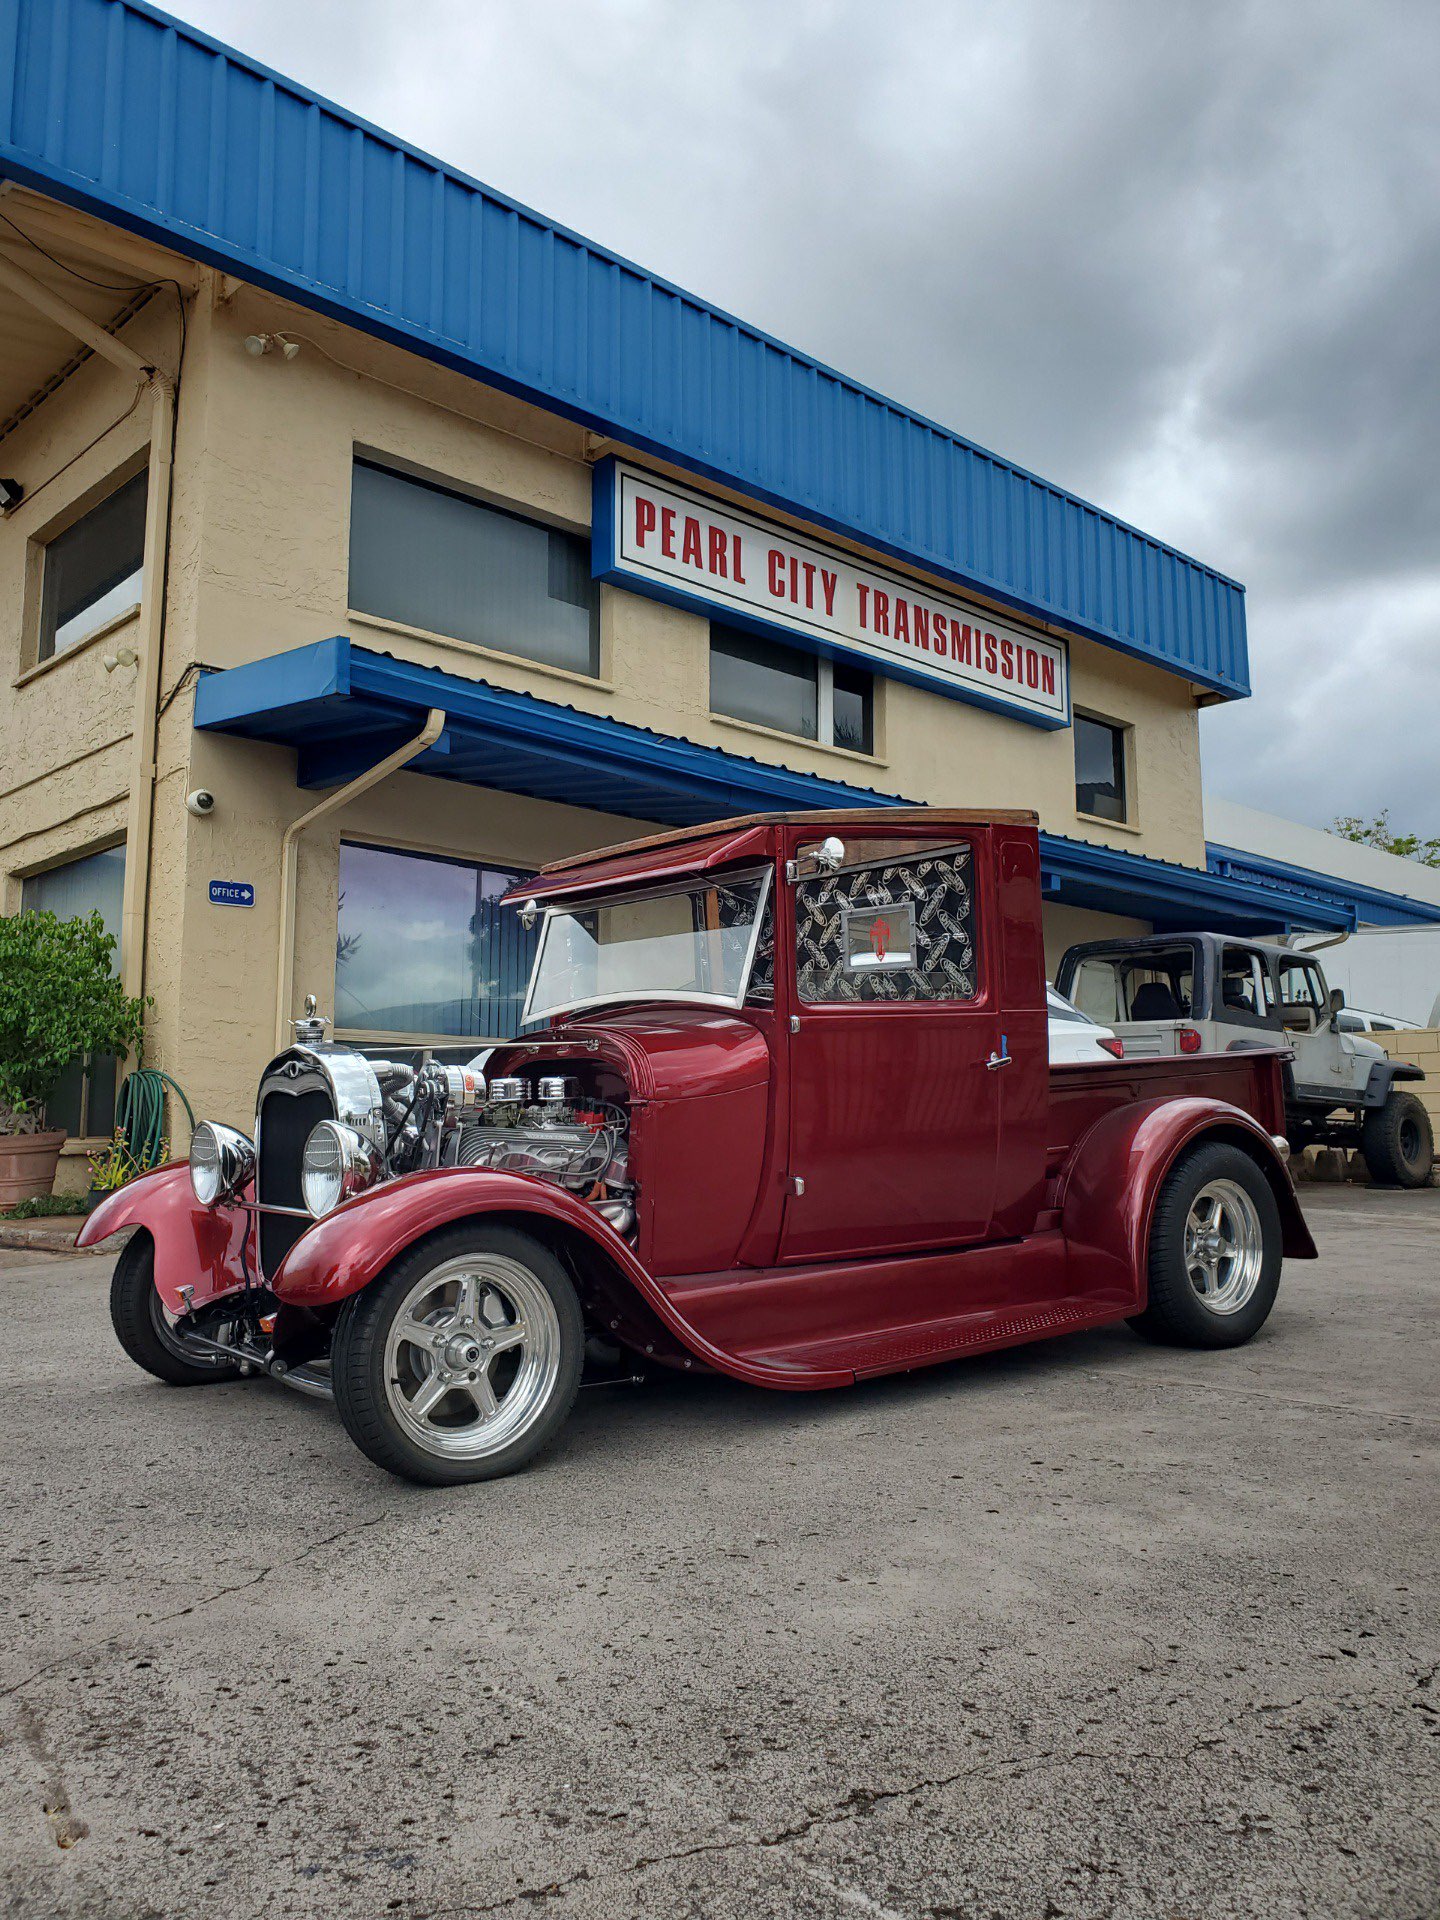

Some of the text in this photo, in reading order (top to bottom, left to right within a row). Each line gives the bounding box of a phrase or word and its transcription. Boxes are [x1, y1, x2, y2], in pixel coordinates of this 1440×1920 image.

[635, 497, 1055, 696] PEARL CITY TRANSMISSION
[211, 887, 240, 898] OFFICE
